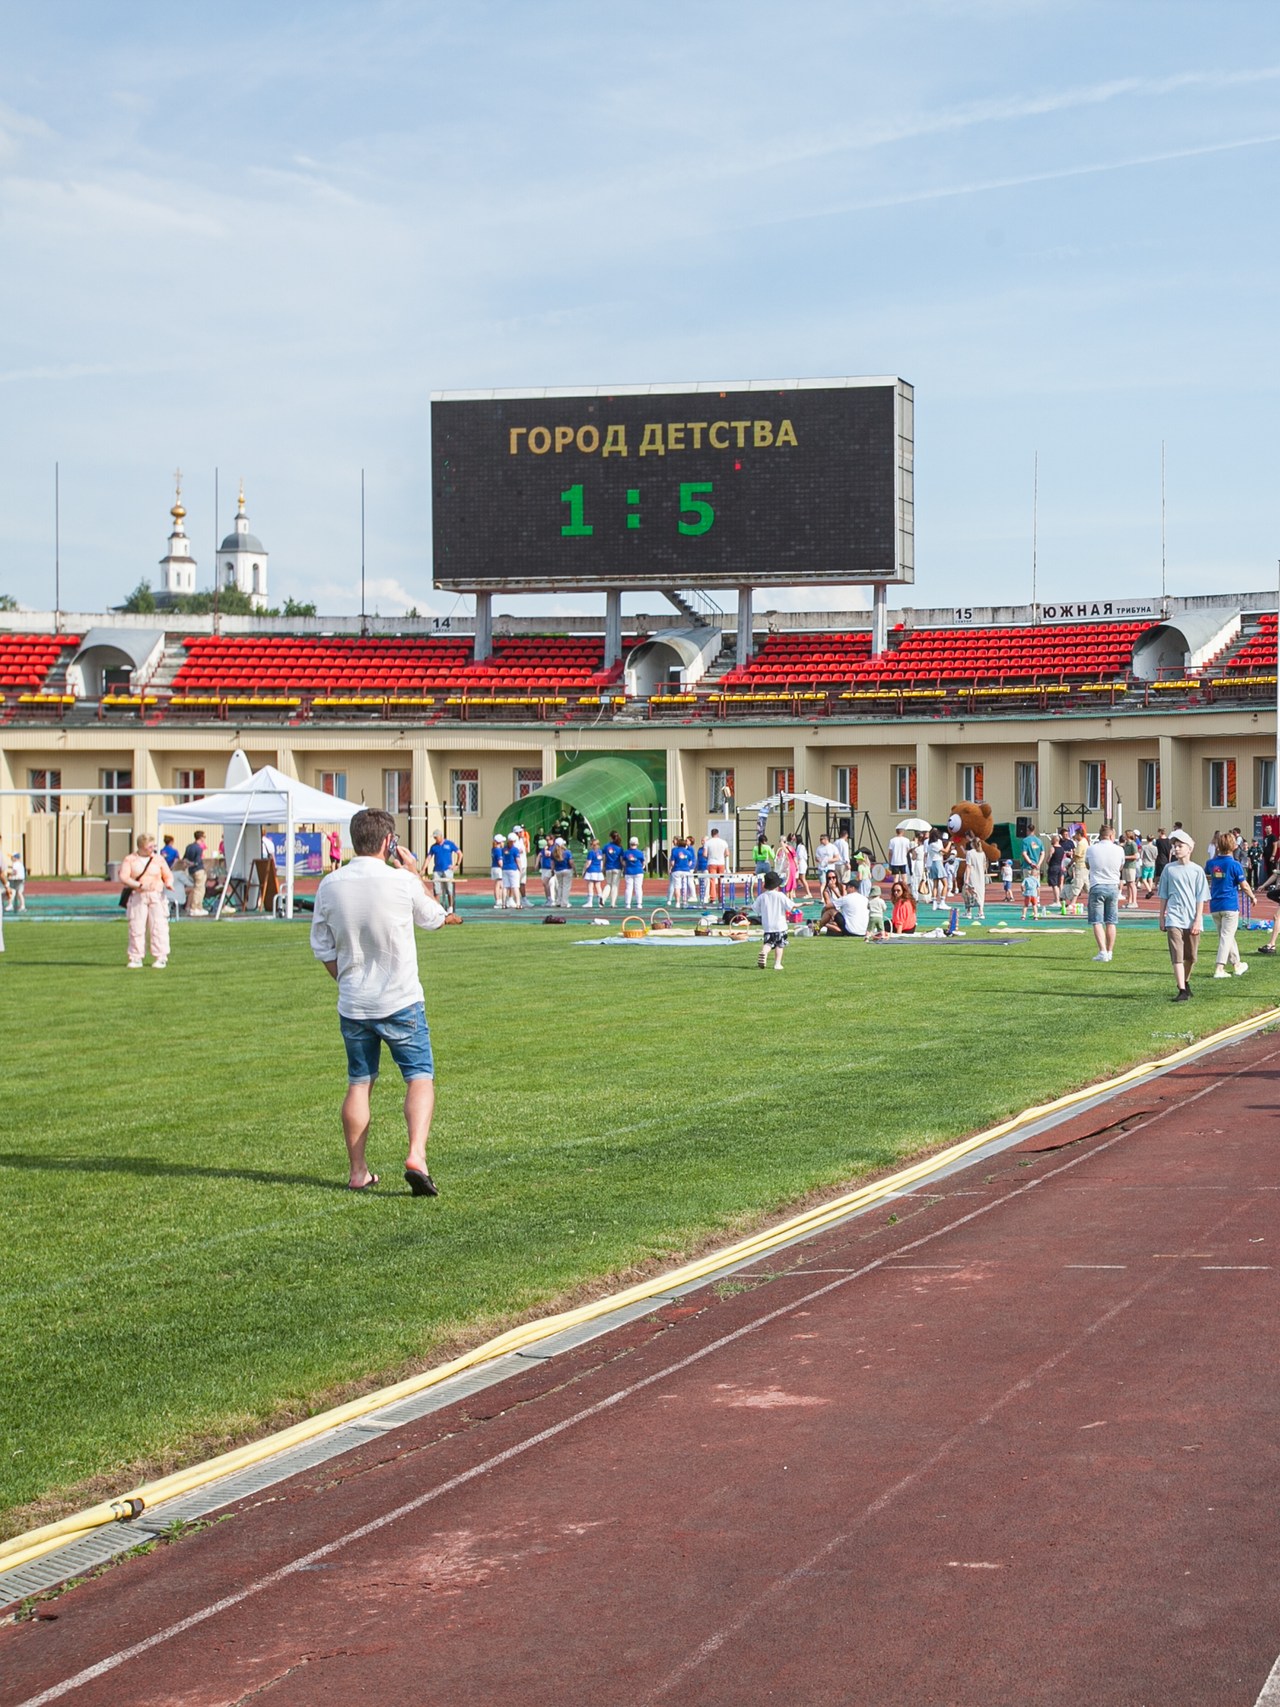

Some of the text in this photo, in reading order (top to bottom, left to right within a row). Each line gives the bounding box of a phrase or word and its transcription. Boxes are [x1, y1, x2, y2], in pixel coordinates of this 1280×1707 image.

[509, 419, 798, 457] ГОРОД ДЕТСТВА
[560, 484, 593, 537] 1
[677, 482, 715, 536] 5
[955, 608, 972, 620] 15
[1043, 602, 1152, 618] ЮЖНАЯ ТРИБУНА
[432, 616, 451, 628] 14
